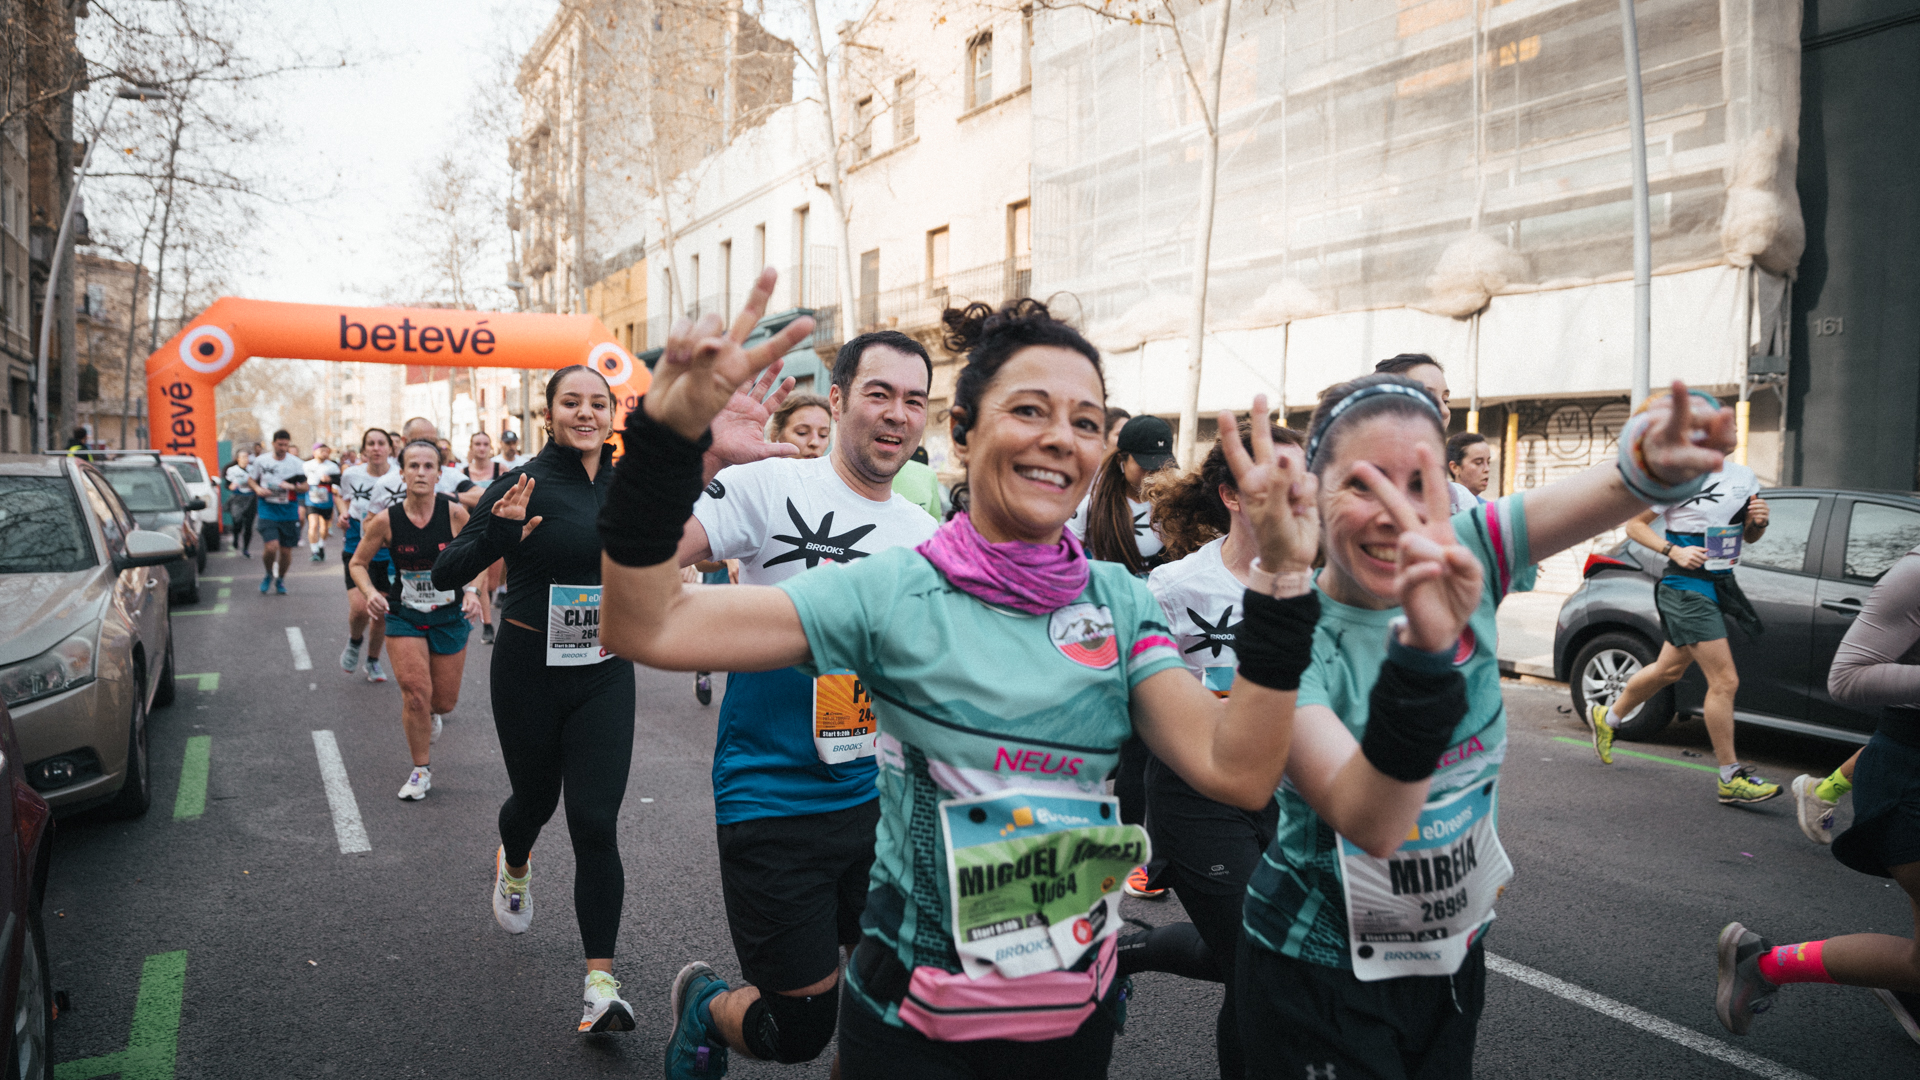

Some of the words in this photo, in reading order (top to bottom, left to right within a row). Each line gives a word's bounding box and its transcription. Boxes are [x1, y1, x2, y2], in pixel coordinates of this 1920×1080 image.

[340, 314, 496, 355] betevé
[1811, 316, 1844, 336] 161
[161, 382, 196, 457] tevé
[805, 541, 845, 556] BROOKS
[581, 628, 599, 640] 264
[833, 742, 863, 752] BROOKS
[993, 745, 1085, 776] NEUS
[958, 846, 1059, 899] MIGUEL
[1388, 834, 1478, 896] MIREIA
[1383, 950, 1442, 962] BROOKS
